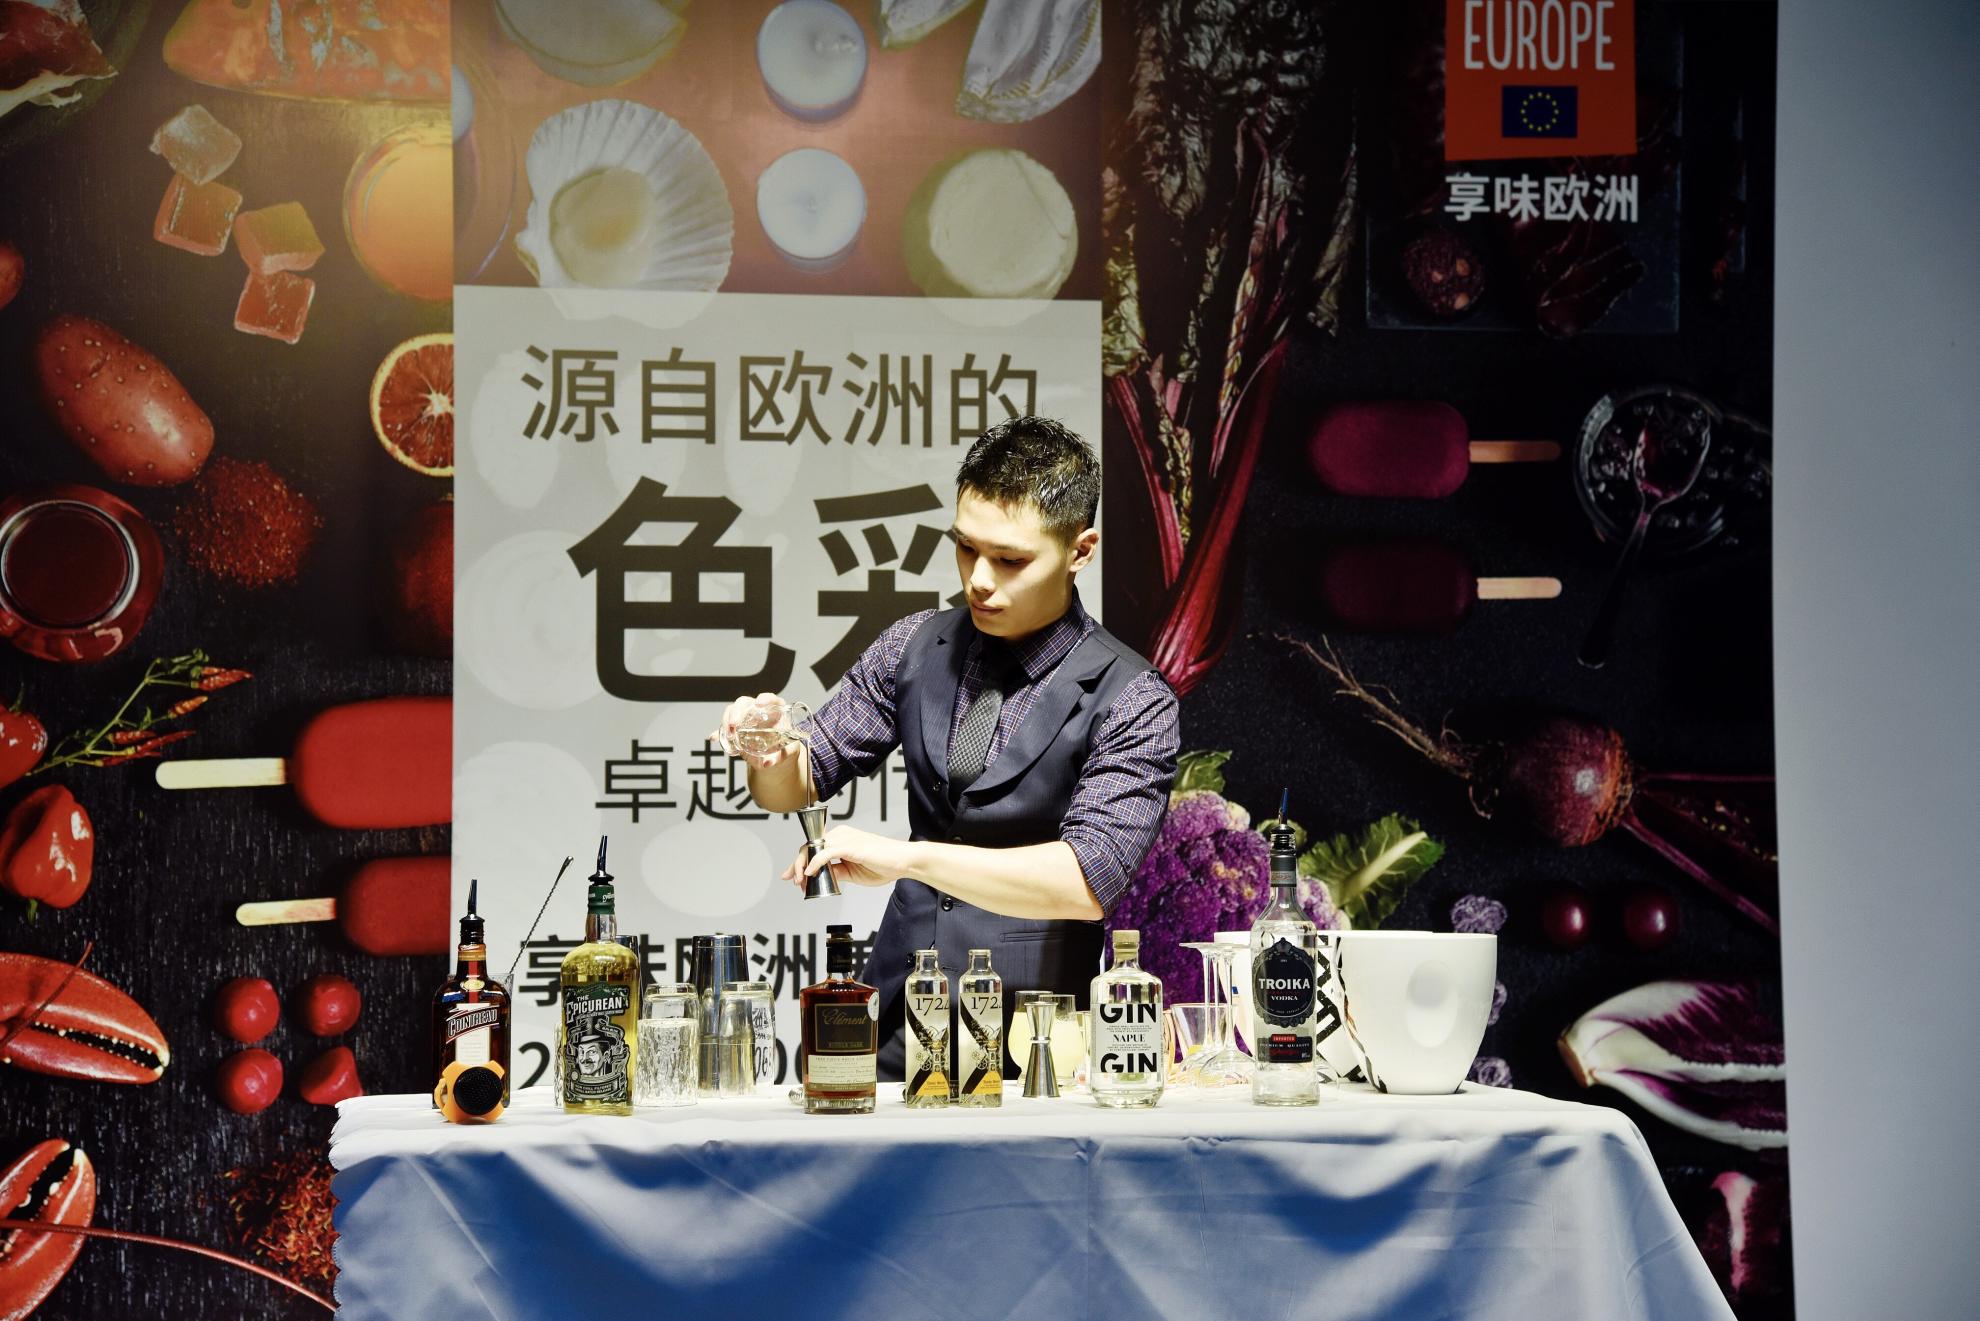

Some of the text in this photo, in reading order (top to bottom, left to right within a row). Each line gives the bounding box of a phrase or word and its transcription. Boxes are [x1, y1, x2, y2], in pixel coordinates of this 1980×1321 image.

[1464, 0, 1615, 70] EUROPE
[1444, 172, 1638, 223] 享味欧洲
[520, 344, 1038, 447] 源自欧洲的
[1258, 978, 1311, 990] TROIKA
[566, 996, 623, 1024] EPICUREAN
[971, 996, 1002, 1016] 172
[1100, 1003, 1157, 1024] GIN
[447, 1008, 498, 1038] COINTREAU
[1113, 1034, 1146, 1043] NAPUE
[1101, 1053, 1157, 1073] GIN
